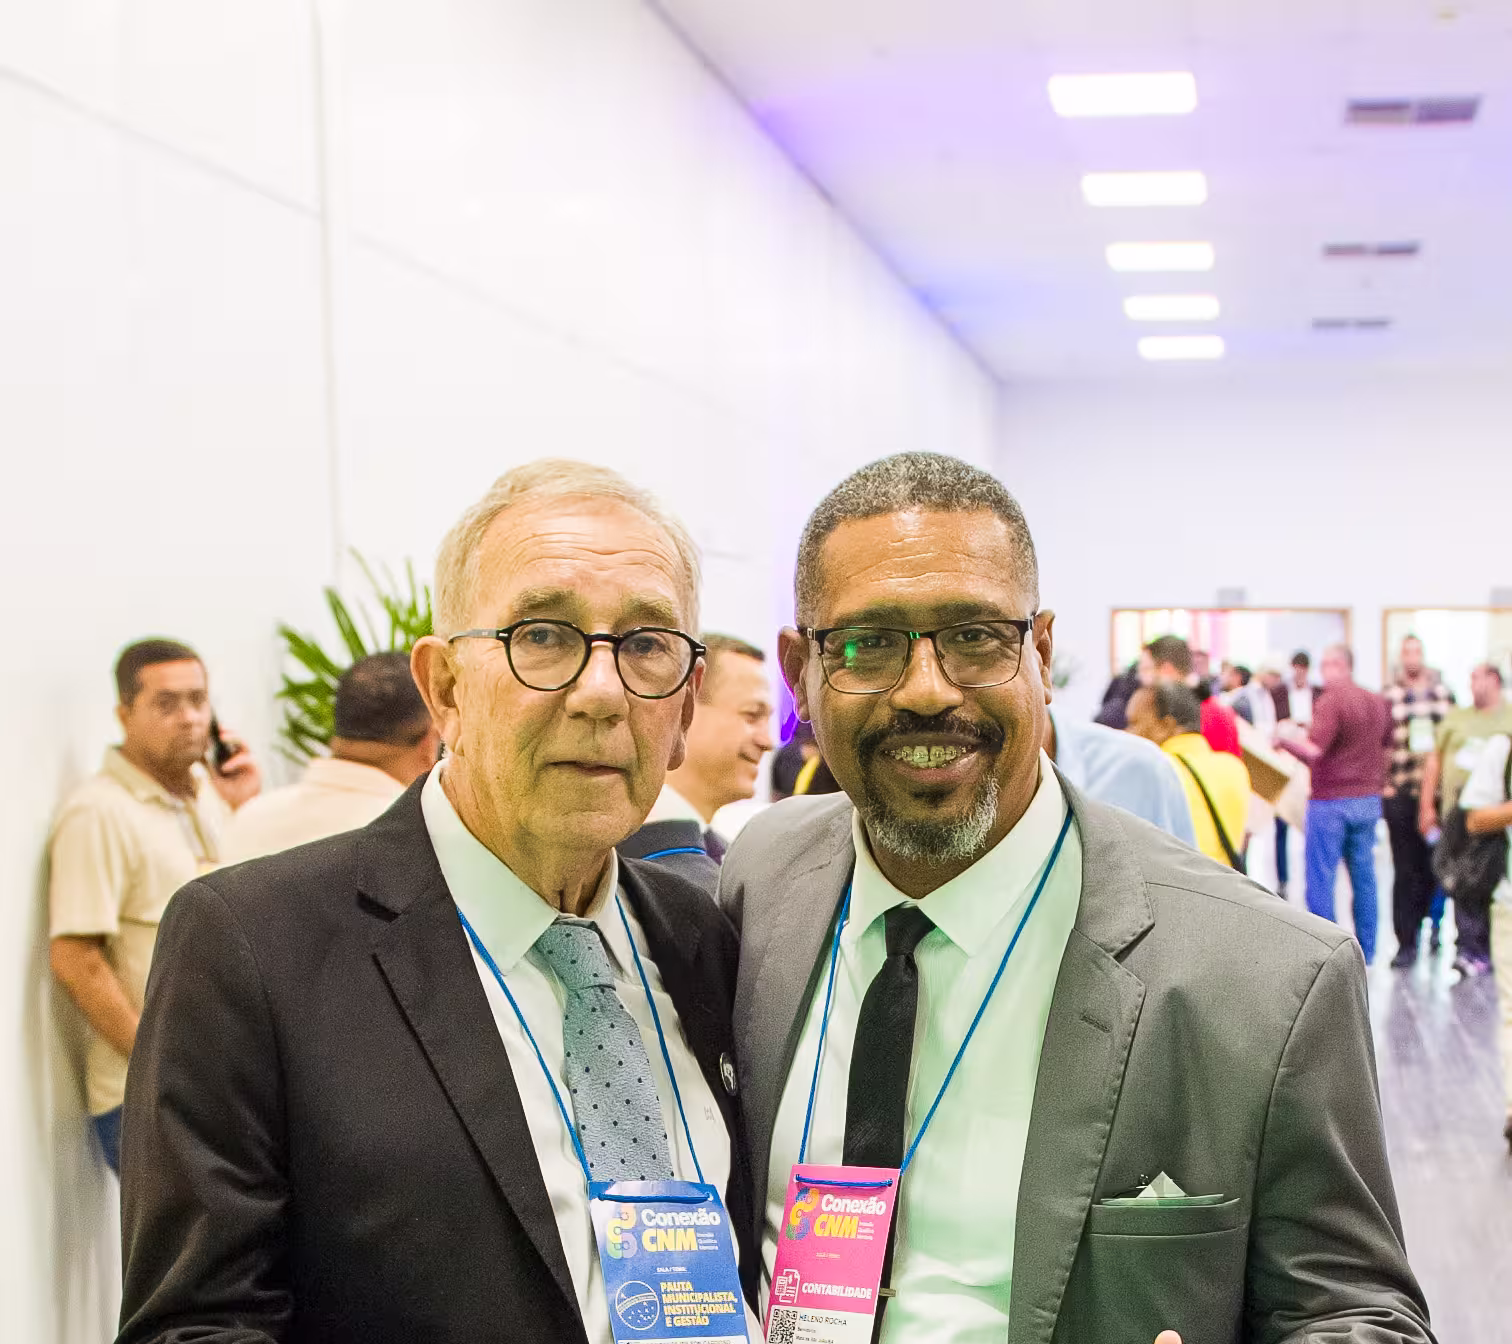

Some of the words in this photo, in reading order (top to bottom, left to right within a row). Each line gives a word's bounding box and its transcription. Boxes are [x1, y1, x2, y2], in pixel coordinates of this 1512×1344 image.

[821, 1194, 887, 1215] Conexão
[641, 1208, 720, 1226] Conexão
[814, 1214, 859, 1238] CNM
[642, 1228, 698, 1252] CNM
[660, 1281, 694, 1293] PAUTA
[801, 1282, 873, 1299] CONTABILIDADE
[663, 1303, 737, 1316] INSTITUCIONAL
[665, 1315, 673, 1327] E
